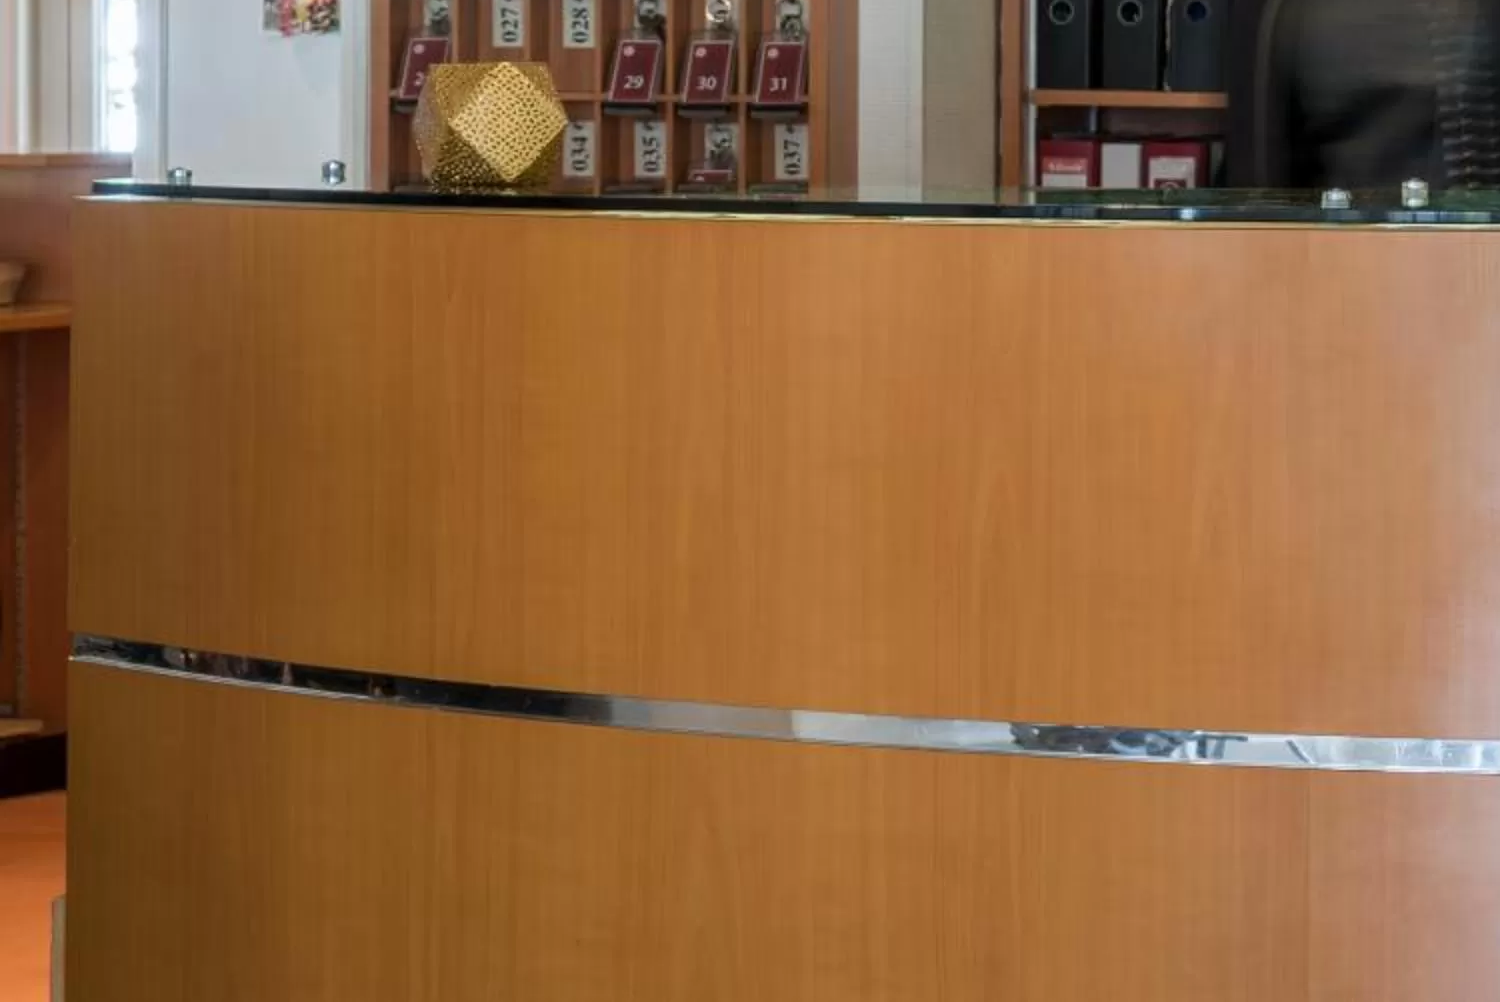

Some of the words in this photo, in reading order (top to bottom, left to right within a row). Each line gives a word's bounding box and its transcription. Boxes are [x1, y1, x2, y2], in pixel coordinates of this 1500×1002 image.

[501, 7, 519, 43] 027
[572, 7, 590, 43] 028
[624, 75, 644, 89] 29
[697, 76, 717, 90] 30
[769, 77, 787, 92] 31
[572, 137, 588, 172] 034
[642, 137, 660, 173] 035
[783, 139, 801, 176] 037
